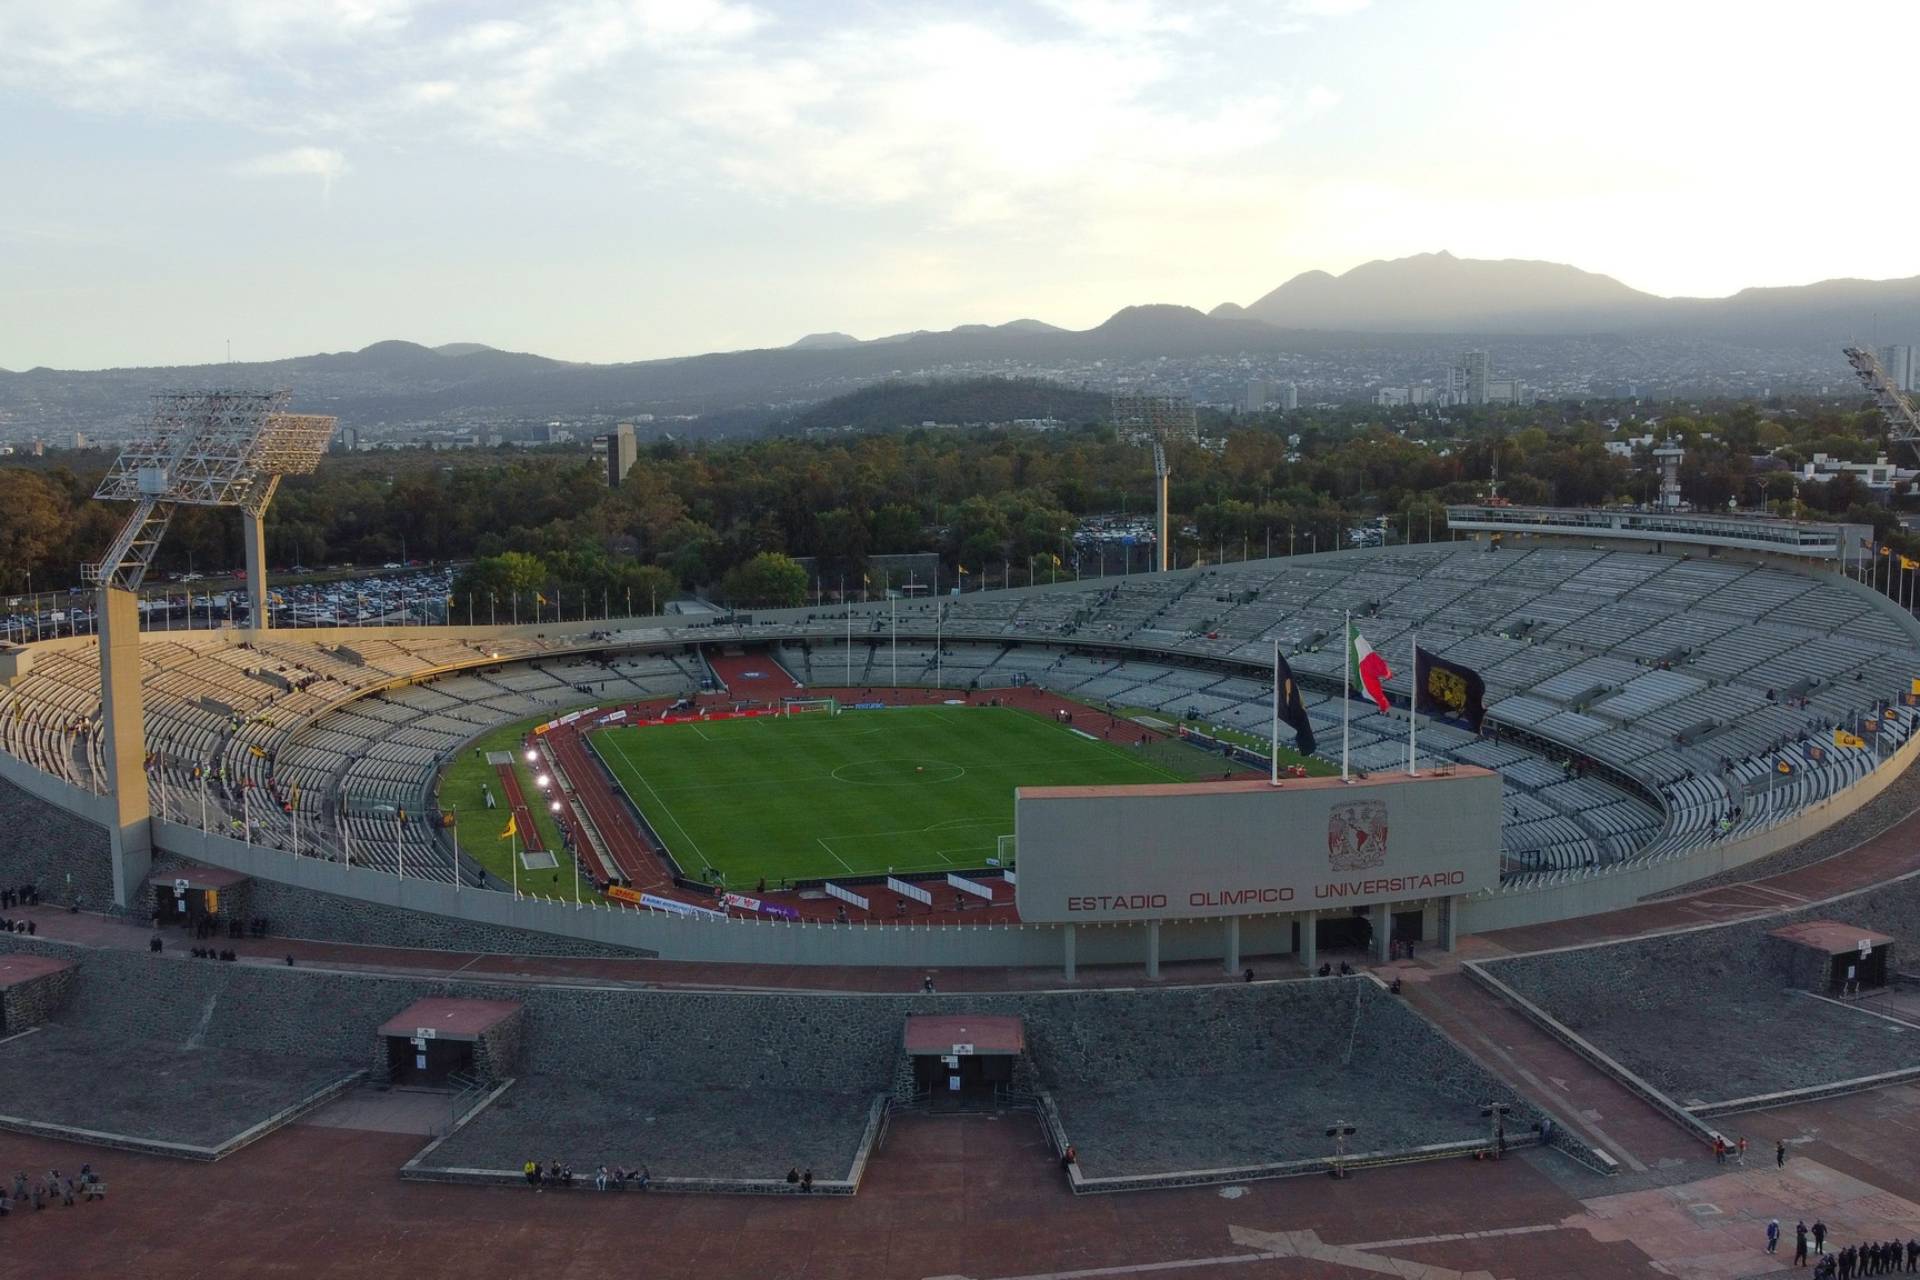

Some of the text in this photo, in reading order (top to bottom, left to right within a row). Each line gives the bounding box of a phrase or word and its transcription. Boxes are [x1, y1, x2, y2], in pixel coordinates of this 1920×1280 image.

[1068, 870, 1464, 911] ESTADIO OLIMPICO UNIVERSITARIO
